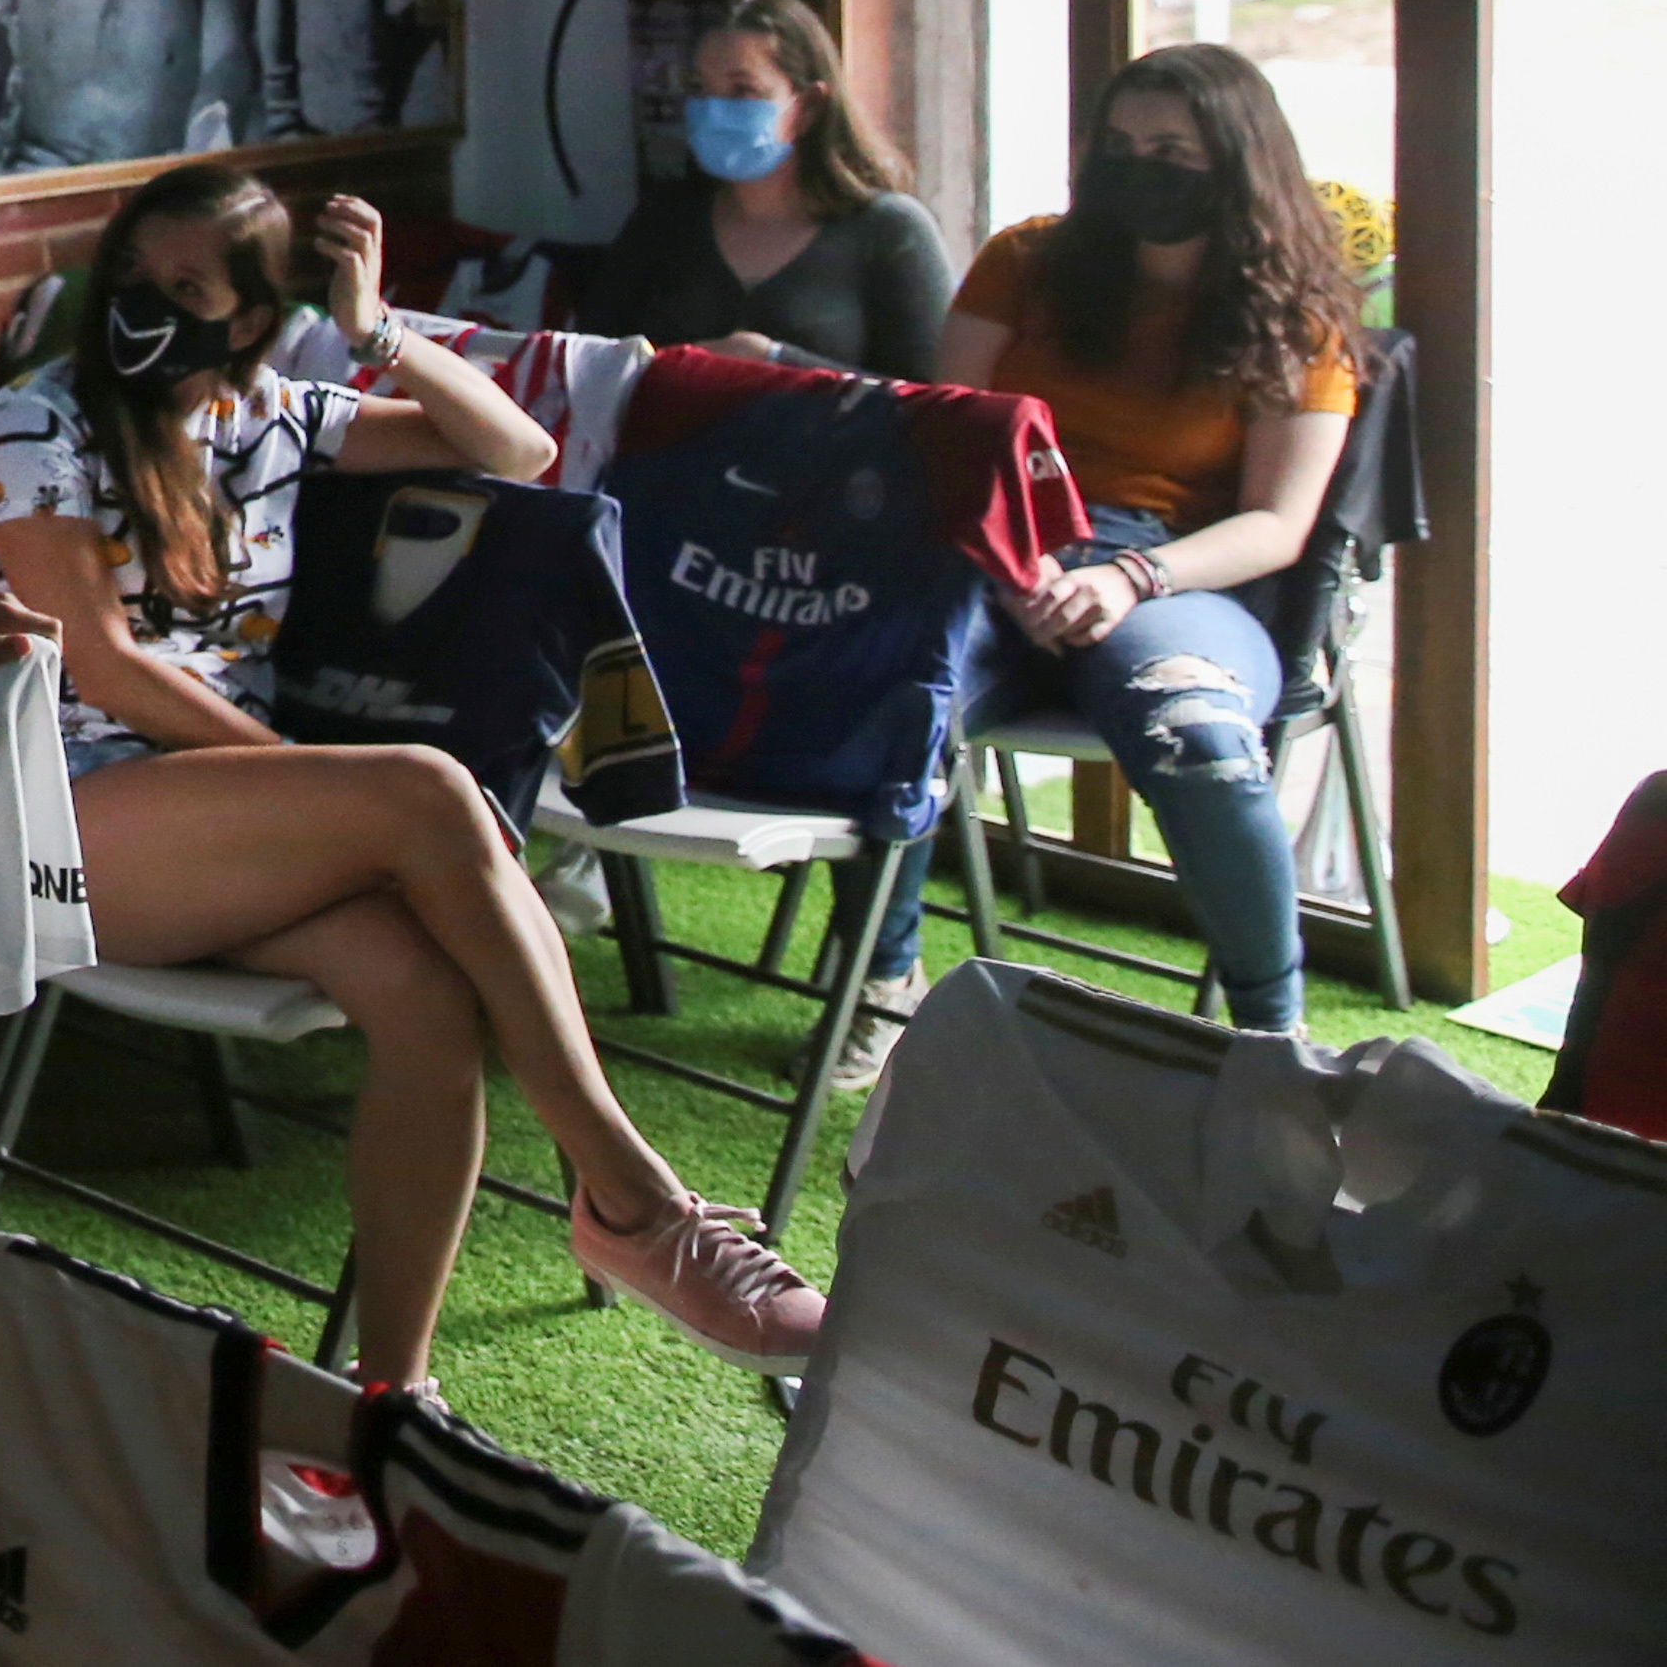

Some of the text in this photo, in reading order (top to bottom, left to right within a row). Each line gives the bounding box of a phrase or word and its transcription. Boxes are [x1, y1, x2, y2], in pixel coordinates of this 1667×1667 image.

[752, 547, 818, 585] Fly
[1170, 1354, 1329, 1465] Fly
[972, 1336, 1520, 1637] Emirates
